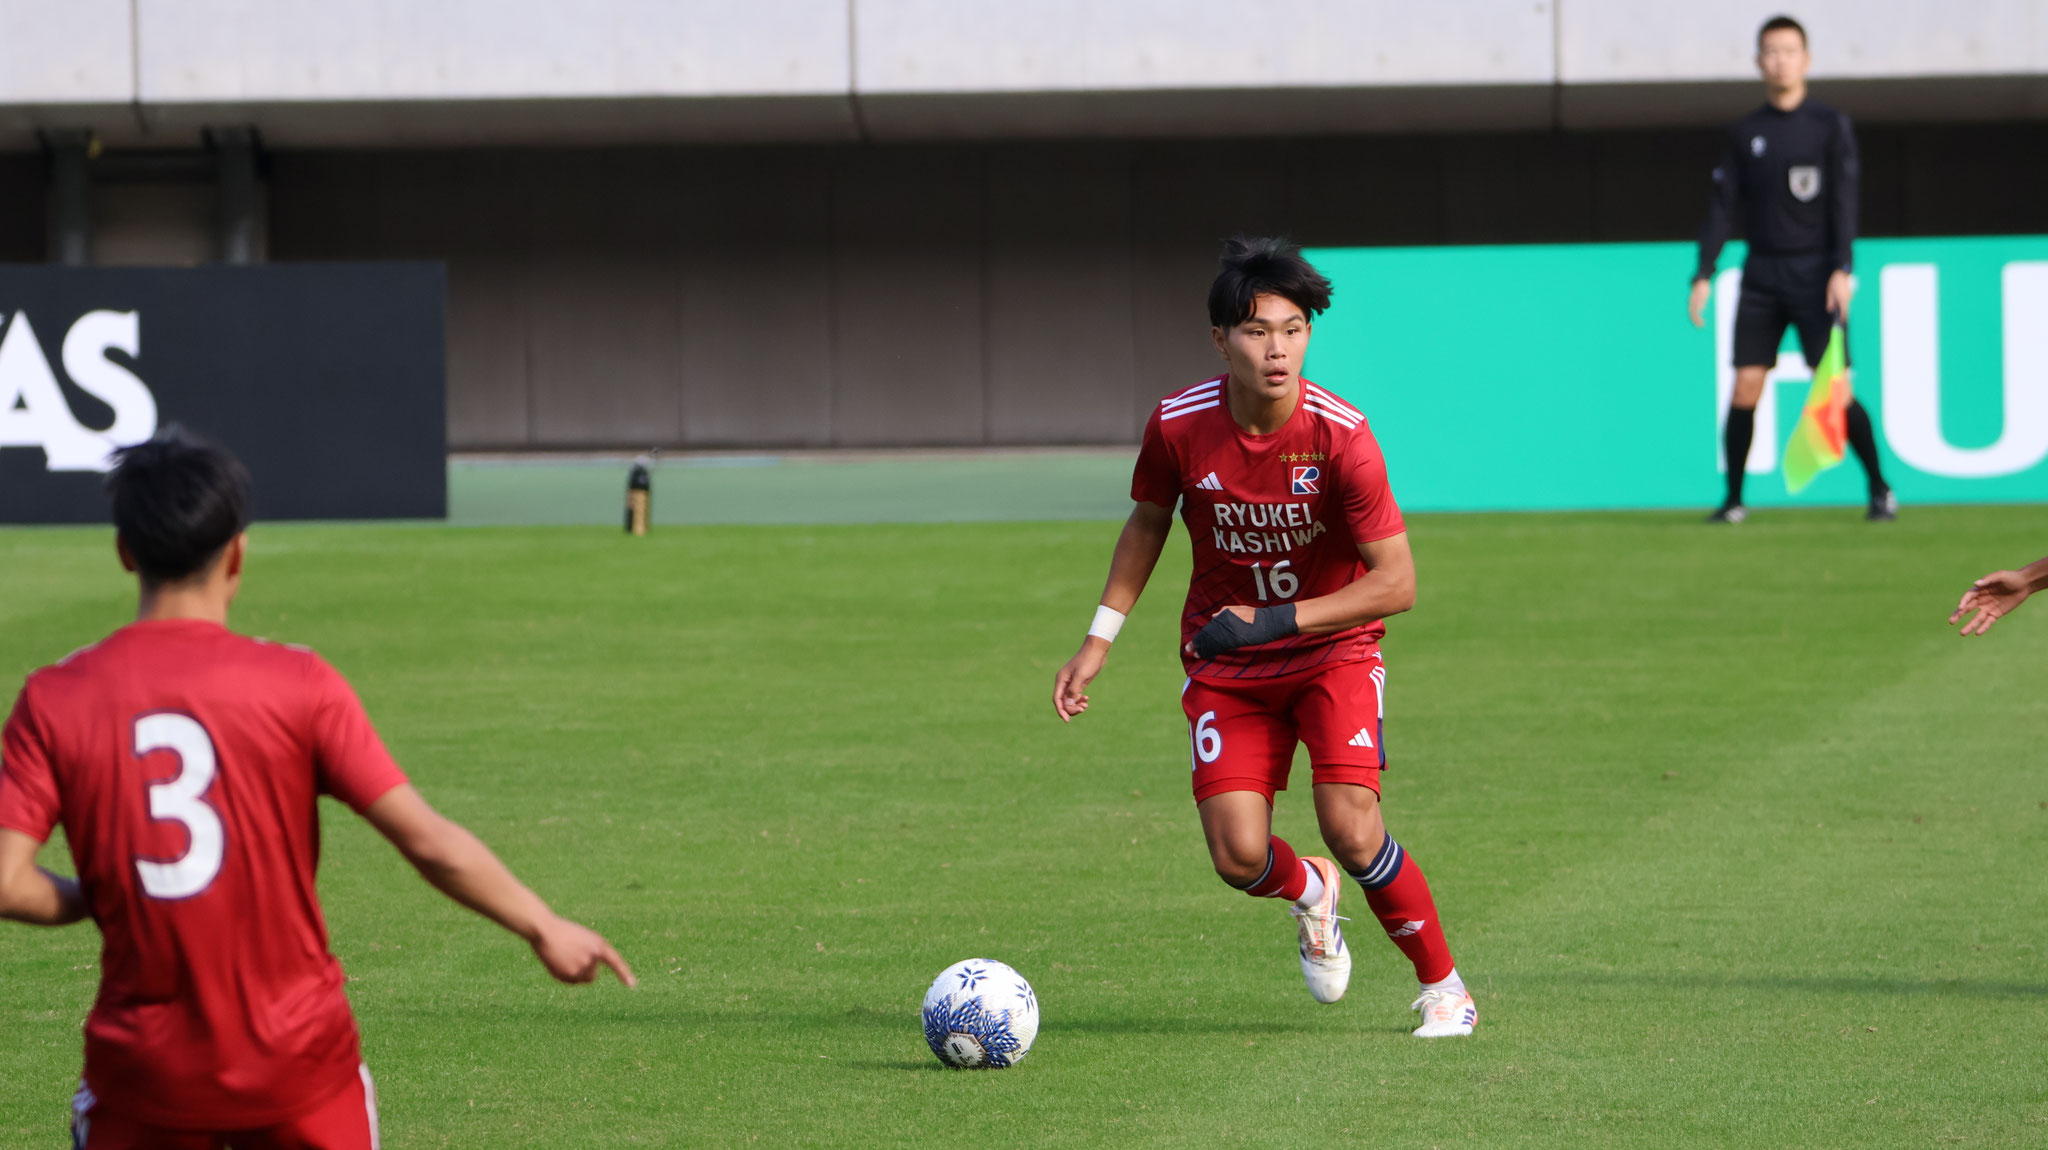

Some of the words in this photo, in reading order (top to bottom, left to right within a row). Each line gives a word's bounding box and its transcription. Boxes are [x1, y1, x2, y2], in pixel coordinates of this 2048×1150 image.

[0, 308, 158, 473] AS
[1213, 502, 1313, 528] RYUKEI
[1212, 519, 1327, 554] KASHIWA
[1250, 559, 1299, 601] 16
[132, 711, 226, 900] 3
